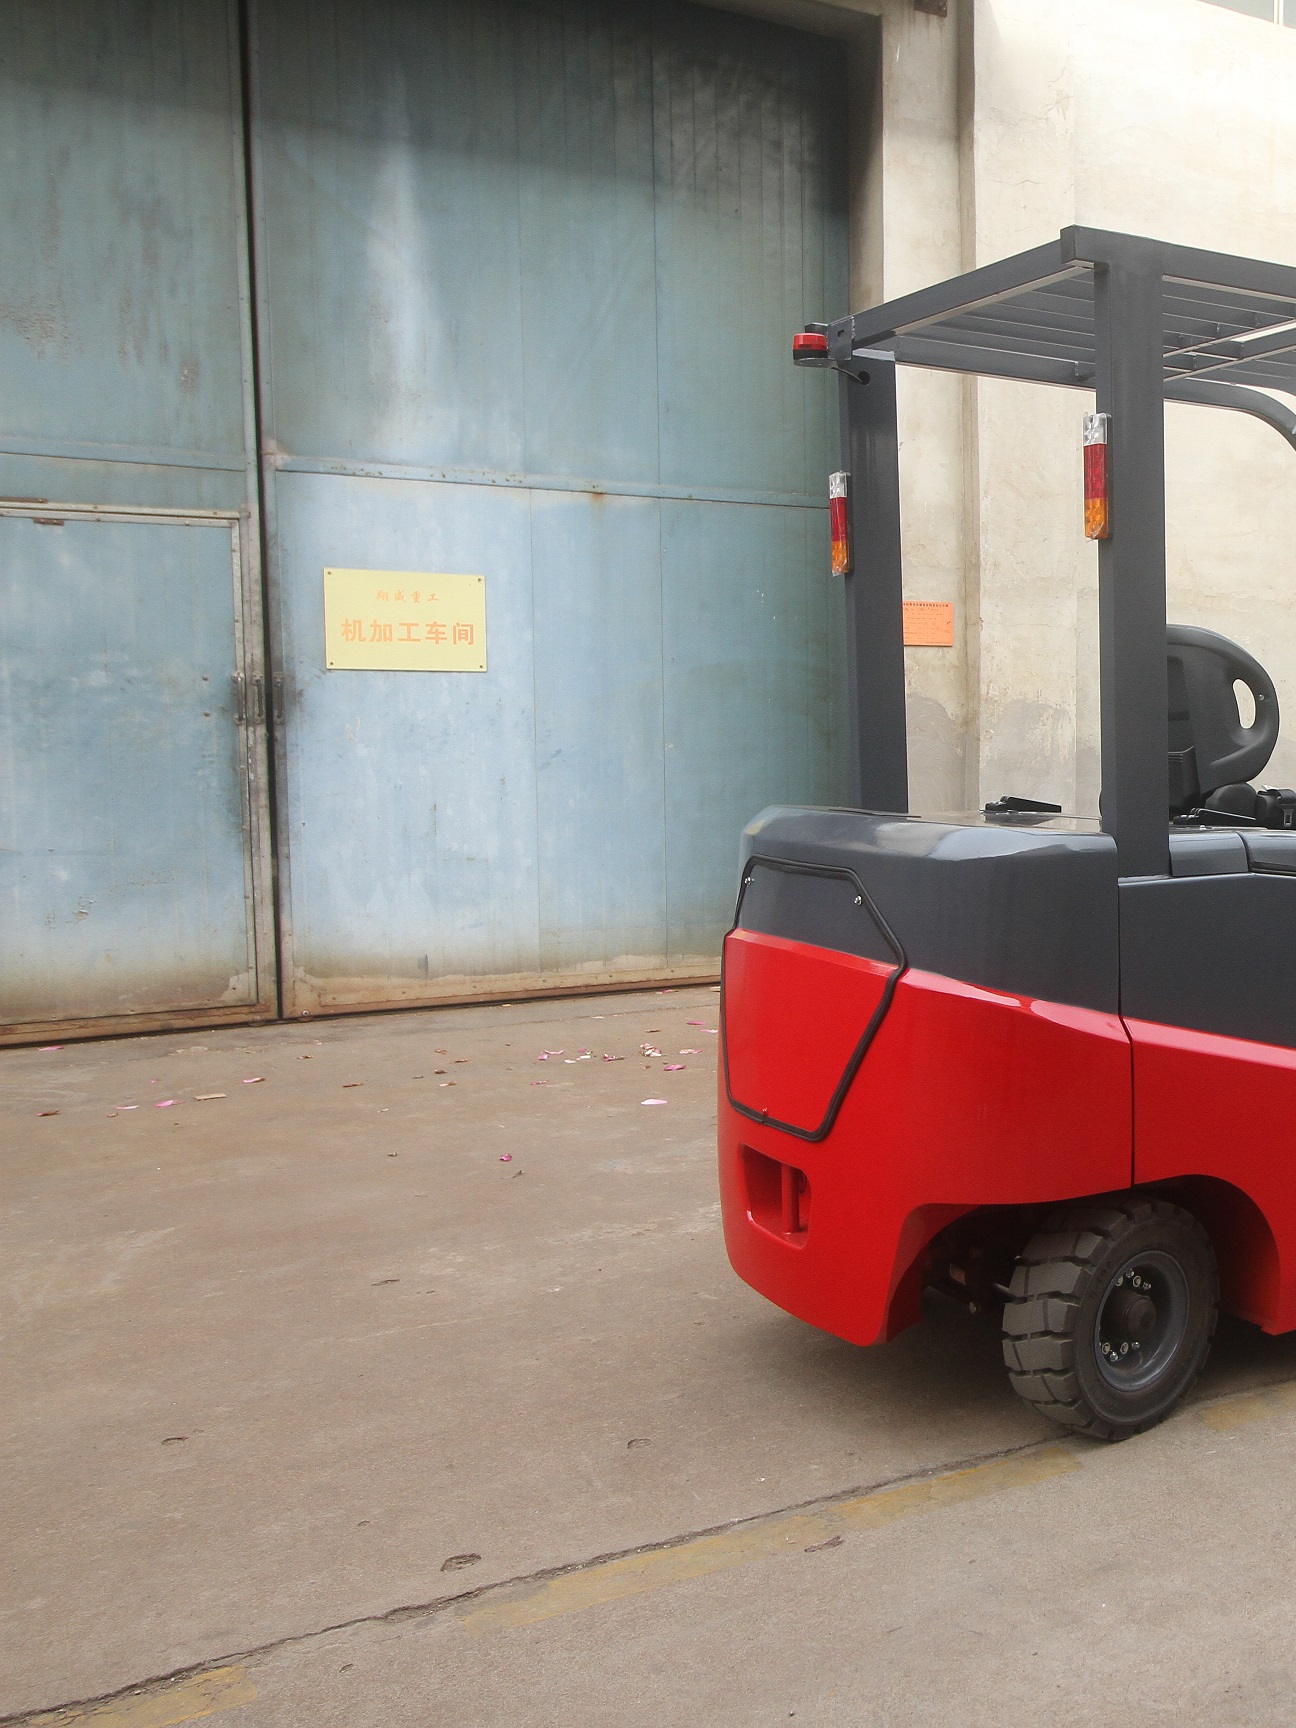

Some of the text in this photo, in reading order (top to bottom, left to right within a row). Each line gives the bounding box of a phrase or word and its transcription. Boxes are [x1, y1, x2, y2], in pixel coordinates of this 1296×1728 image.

[341, 619, 475, 645] 机加工车间
